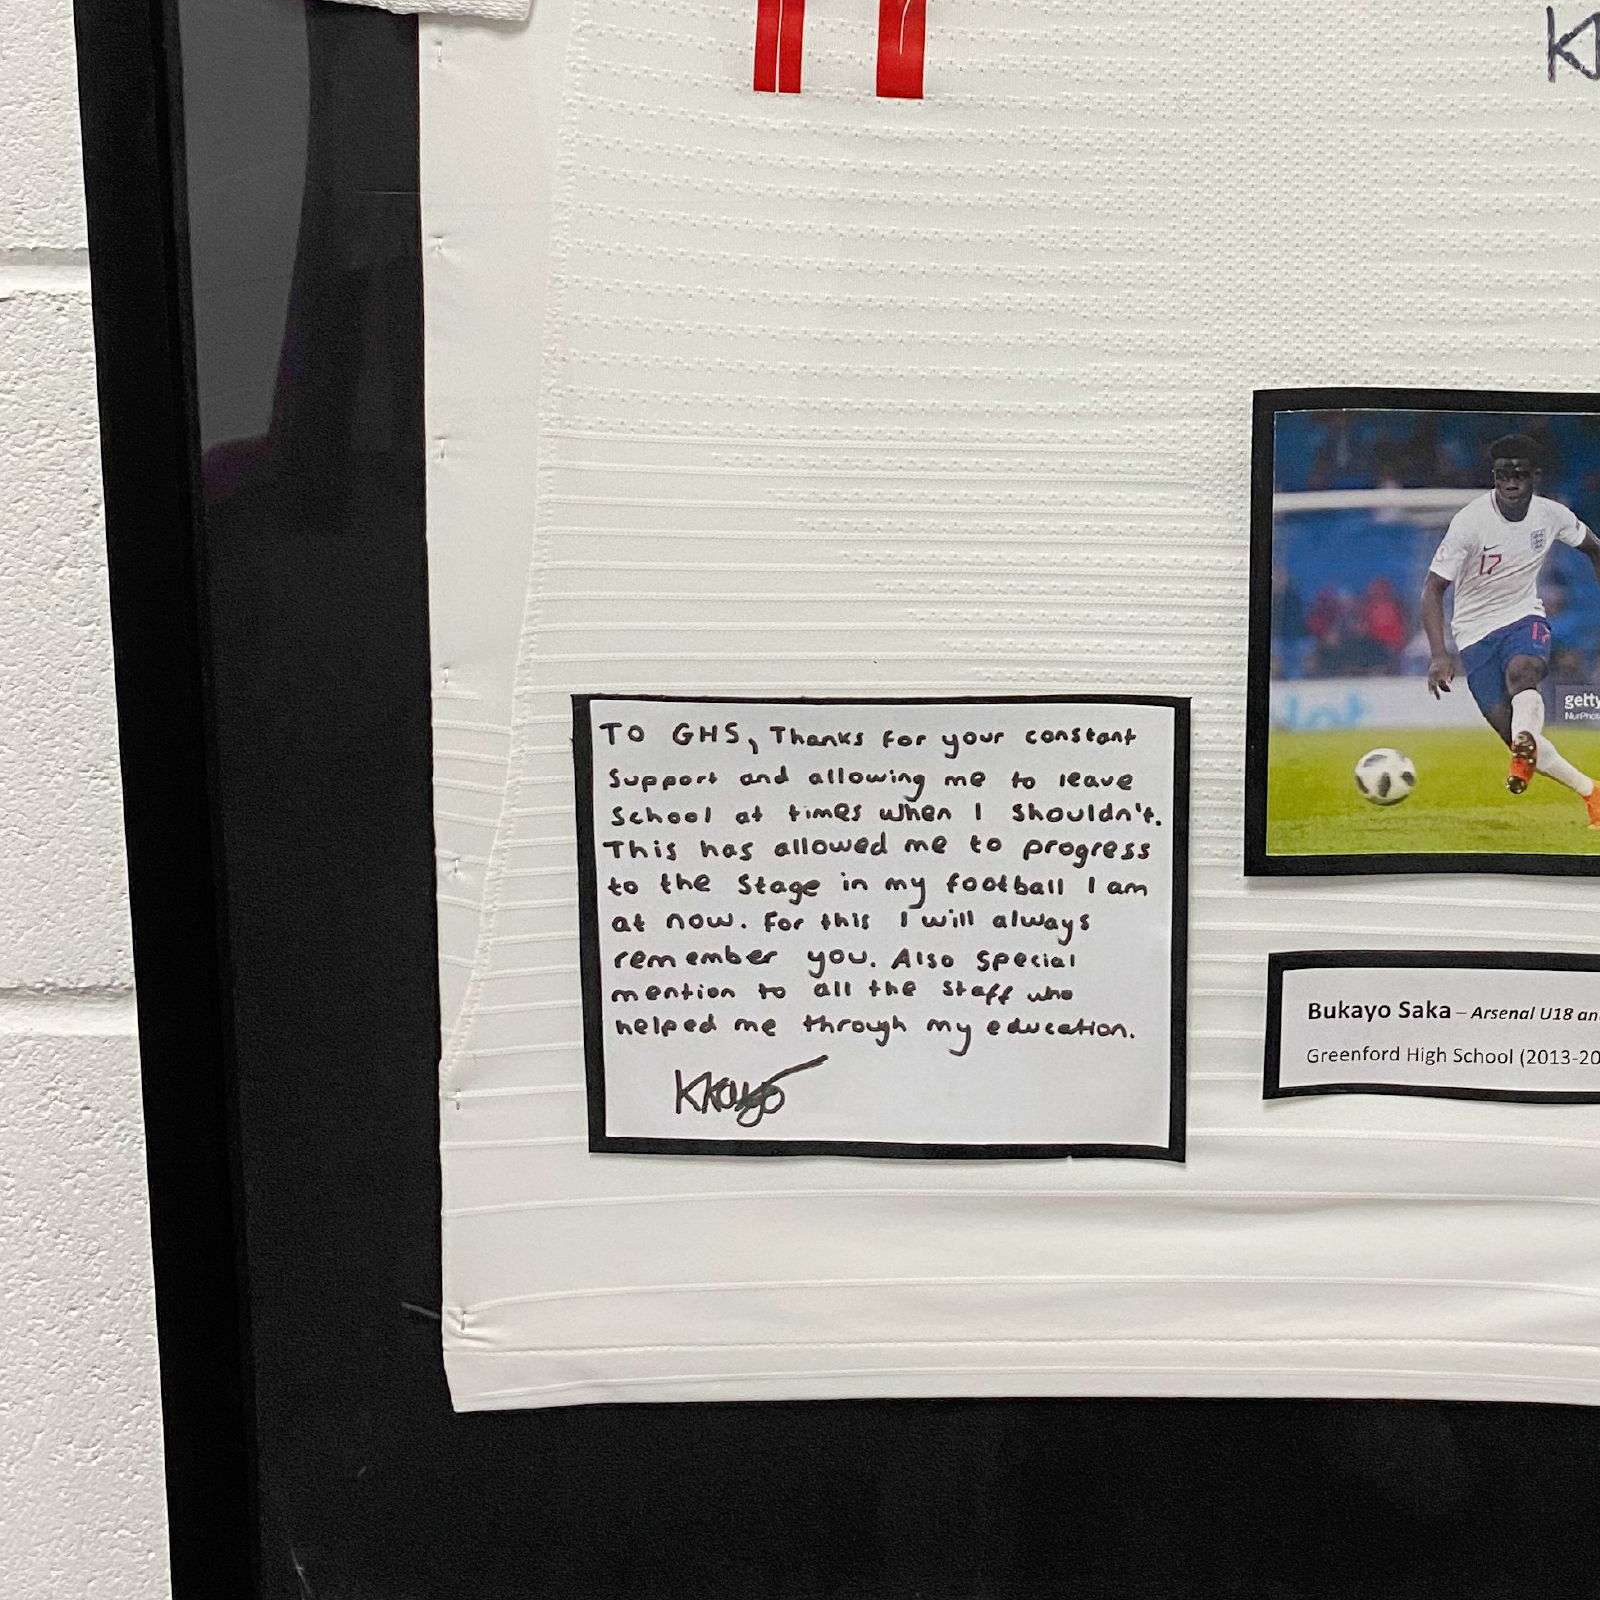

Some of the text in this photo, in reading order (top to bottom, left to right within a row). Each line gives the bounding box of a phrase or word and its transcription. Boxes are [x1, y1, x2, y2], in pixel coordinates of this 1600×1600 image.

[1479, 553, 1503, 576] 17
[672, 721, 759, 755] GHS,
[769, 725, 864, 748] Thanks
[941, 731, 1005, 760] your
[1025, 727, 1137, 746] constant
[739, 764, 790, 787] and
[808, 767, 926, 803] allowing
[944, 770, 986, 788] me
[1011, 770, 1036, 790] to
[735, 804, 763, 825] at
[788, 802, 863, 823] times
[879, 799, 952, 823] when
[975, 802, 982, 821] I
[602, 831, 1151, 869] This has allowed me to progress
[607, 876, 639, 897] to
[659, 872, 711, 895] the
[840, 871, 869, 892] in
[884, 876, 926, 910] my
[946, 872, 1064, 896] football
[1088, 876, 1096, 894] I
[1106, 880, 1148, 897] am
[611, 912, 646, 933] at
[666, 912, 747, 931] now.
[820, 912, 870, 931] this
[900, 910, 908, 928] I
[921, 908, 975, 929] will
[992, 909, 1090, 947] always
[807, 949, 876, 980] you.
[610, 982, 736, 1003] mention
[757, 982, 787, 1000] to
[813, 979, 852, 998] all
[868, 979, 917, 998] the
[1026, 985, 1074, 1003] who
[1308, 1000, 1391, 1023] Bukayo
[1398, 999, 1451, 1019] Saka
[1470, 1006, 1536, 1020] Arsenal
[1540, 1007, 1574, 1021] U18
[615, 1013, 1135, 1057] helped me through my education.
[1306, 1045, 1400, 1064] Greenford
[1407, 1046, 1447, 1066] High
[1453, 1047, 1513, 1065] School
